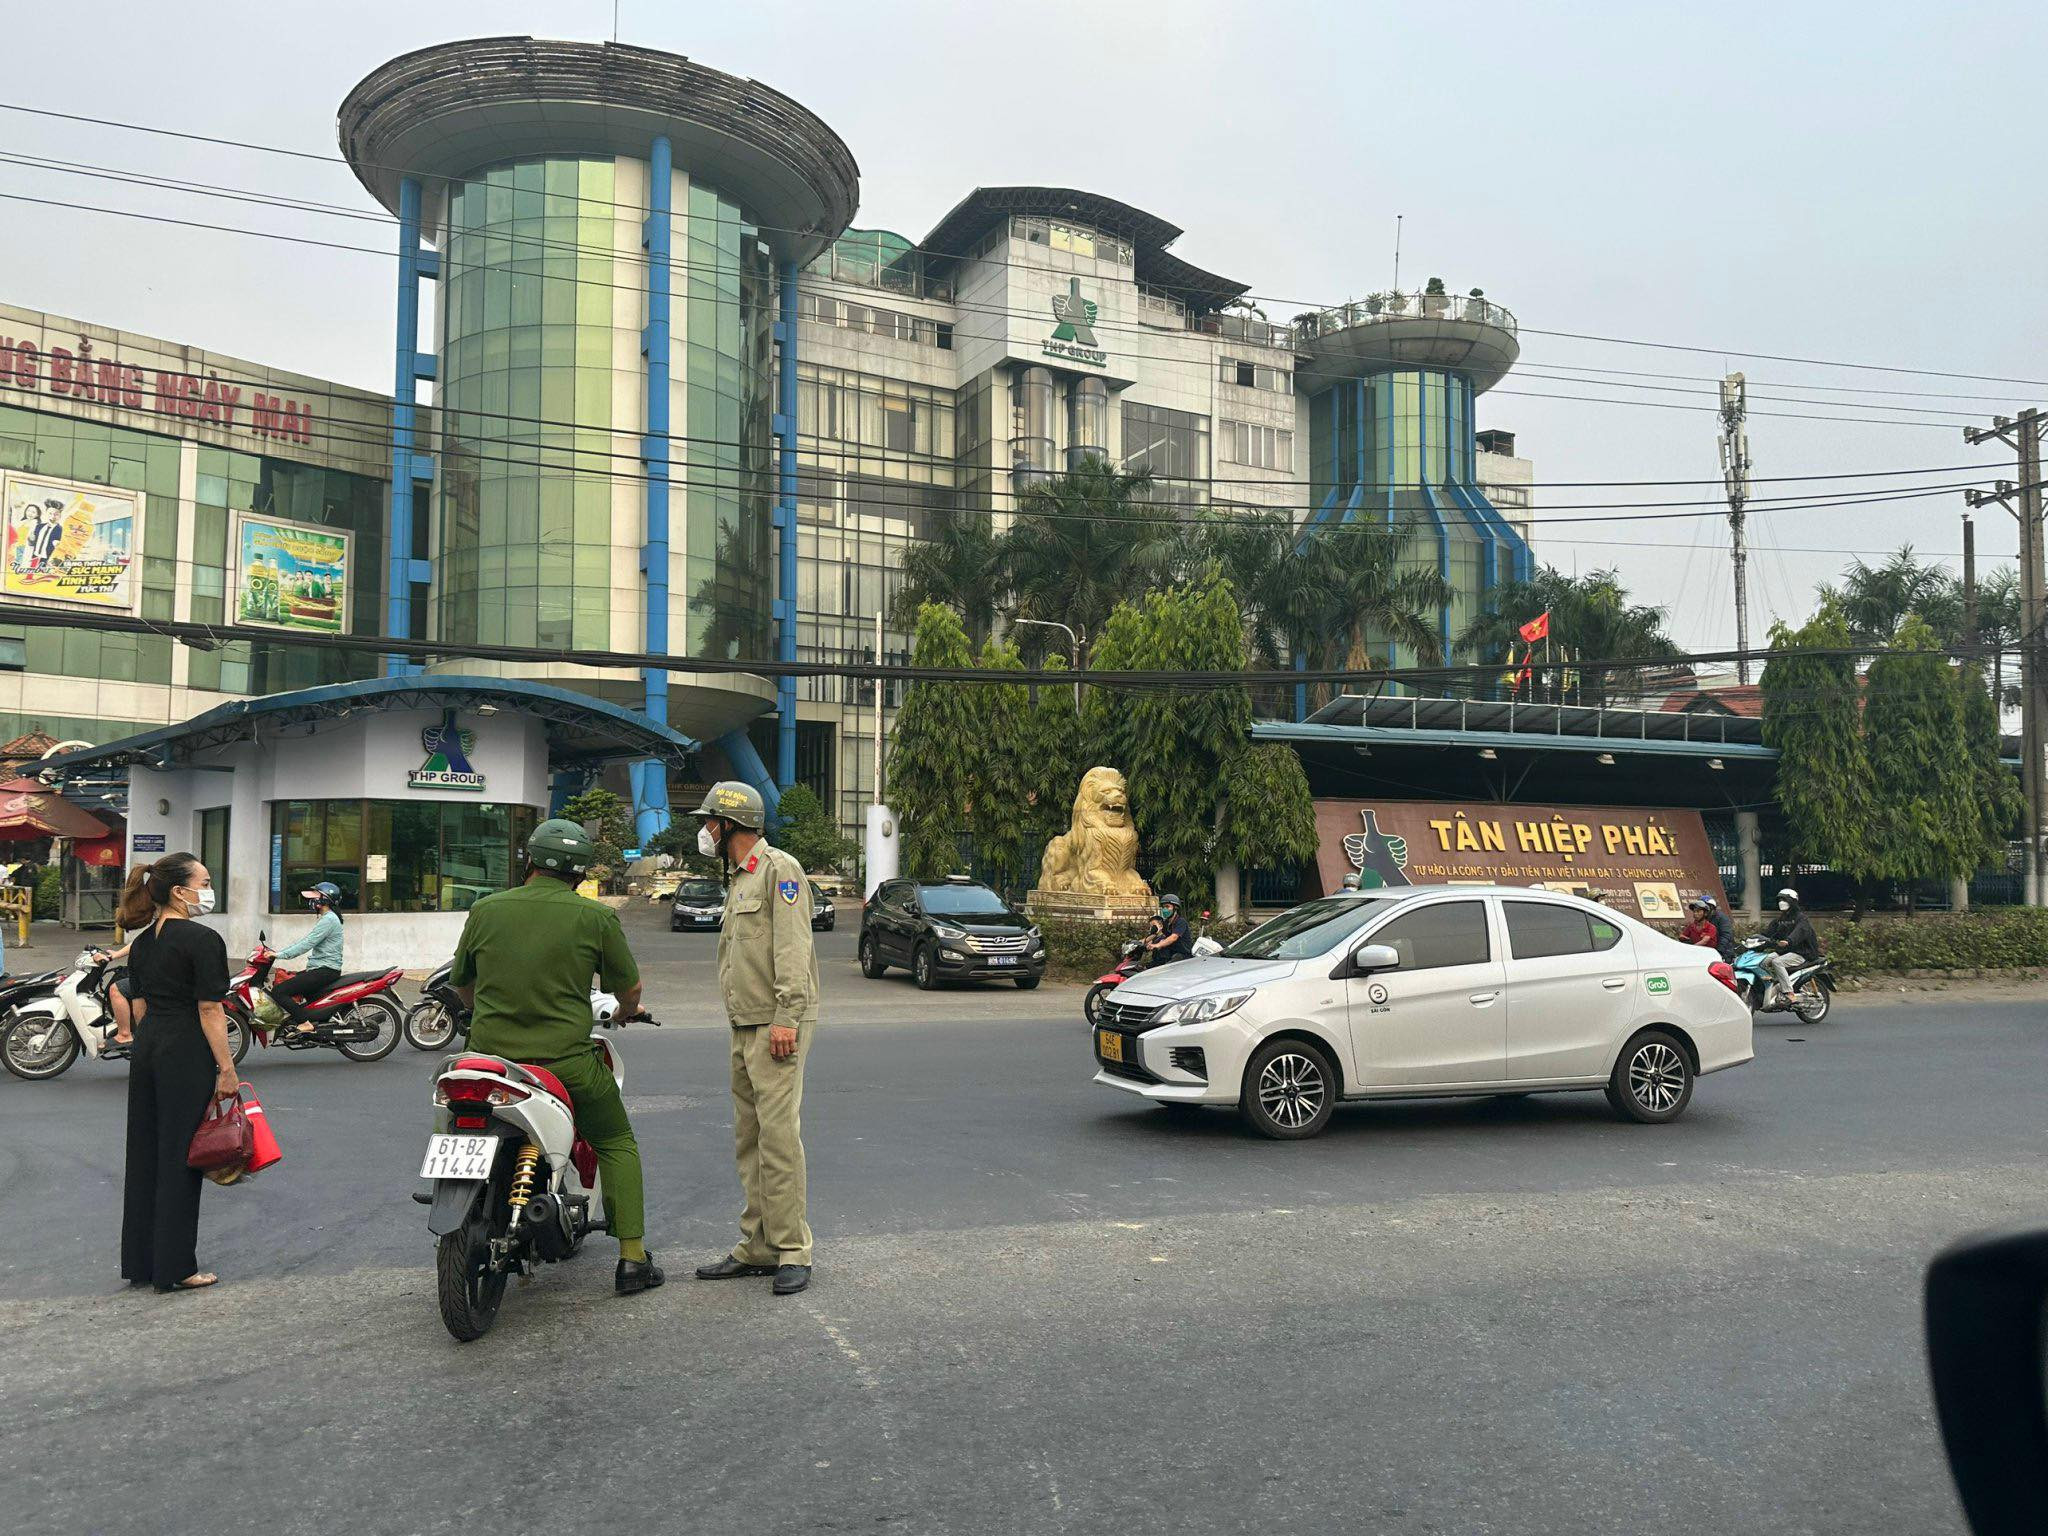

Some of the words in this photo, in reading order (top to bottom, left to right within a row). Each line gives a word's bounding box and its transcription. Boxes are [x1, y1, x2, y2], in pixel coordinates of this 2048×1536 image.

[1042, 339, 1066, 353] THP
[1067, 345, 1107, 362] GROUP
[155, 370, 241, 428] NGÀY
[252, 392, 312, 445] MAI
[410, 771, 437, 782] THP
[440, 772, 485, 785] GROUP
[1430, 811, 1506, 852] TÂN
[1515, 814, 1593, 862] HIỆP
[1602, 816, 1679, 855] PHÁT
[1427, 863, 1446, 877] HÀO
[1459, 864, 1484, 877] CÔNG
[1486, 866, 1498, 877] TY
[1521, 864, 1541, 878] TIÊN
[1556, 865, 1576, 879] VIỆT
[1577, 867, 1597, 878] NAM
[1615, 868, 1622, 879] 3
[1649, 980, 1667, 989] Grab
[439, 1138, 487, 1156] 61-B2
[429, 1157, 487, 1175] 114.44
